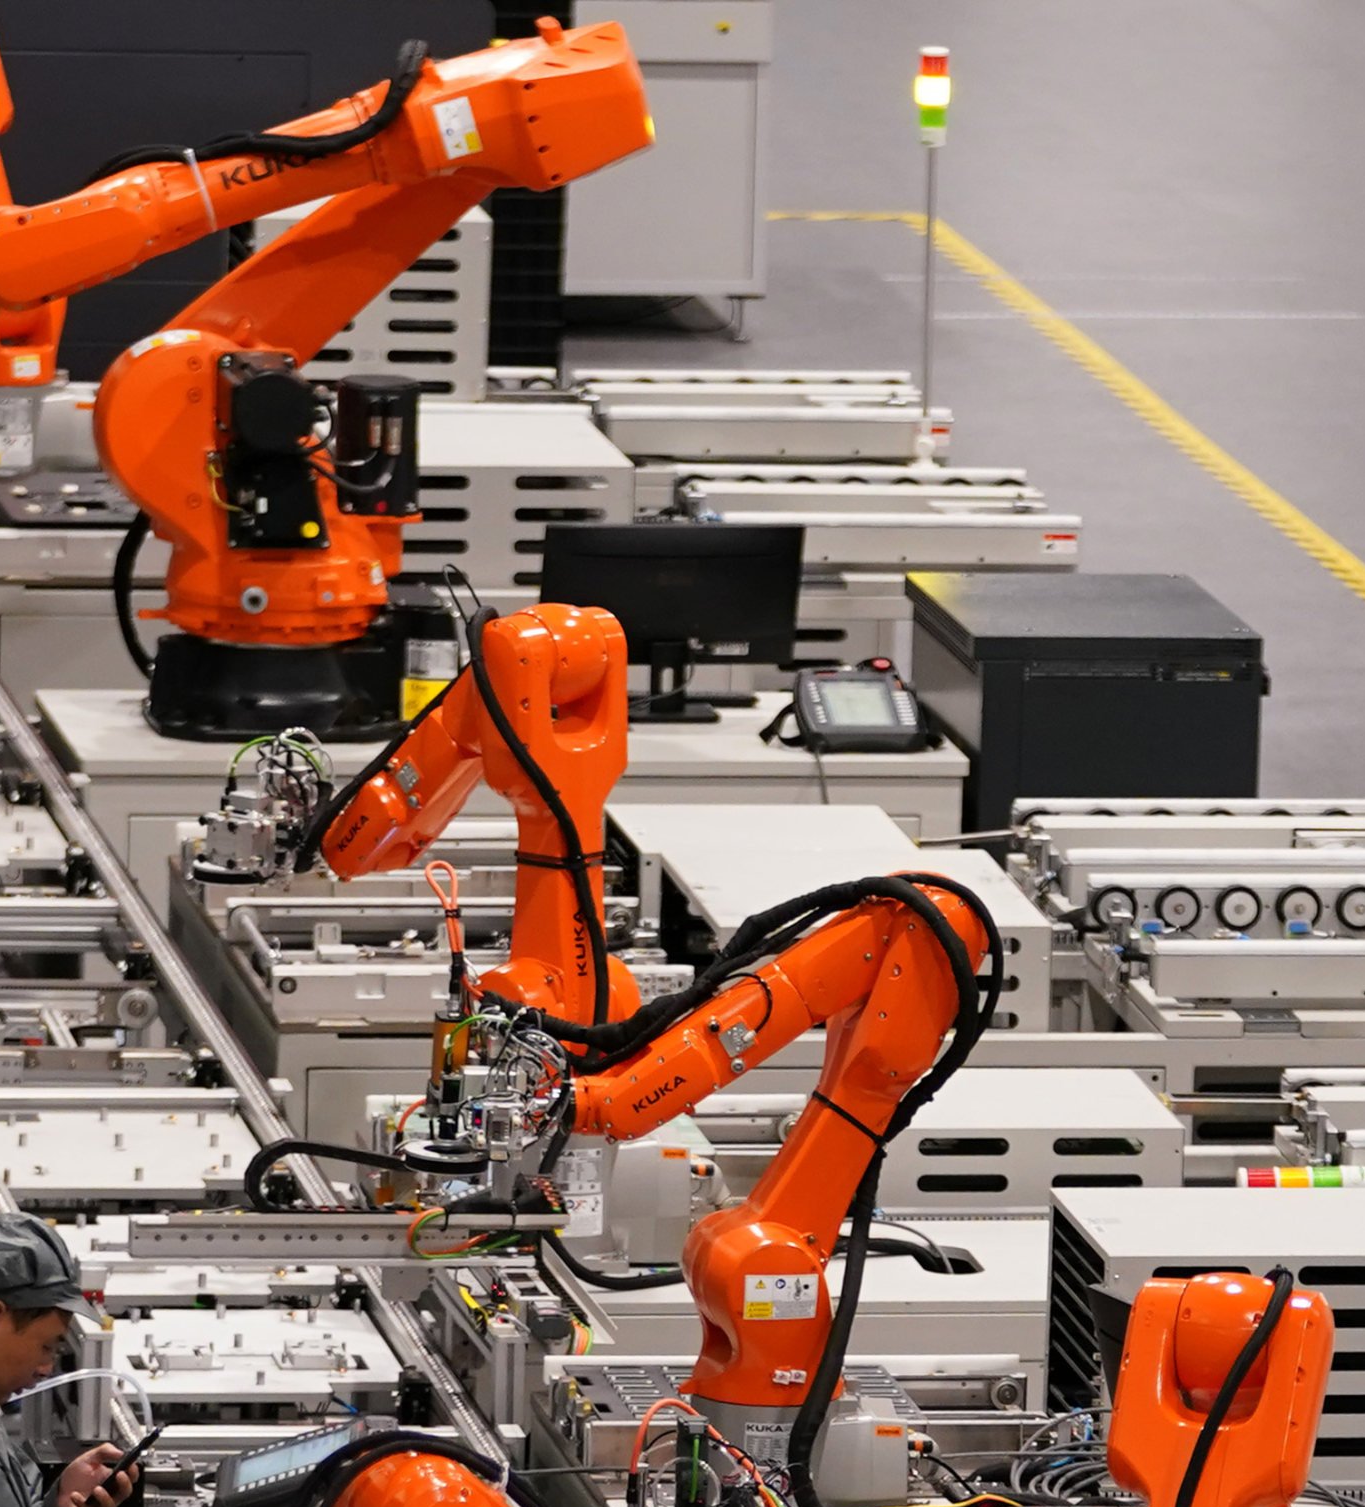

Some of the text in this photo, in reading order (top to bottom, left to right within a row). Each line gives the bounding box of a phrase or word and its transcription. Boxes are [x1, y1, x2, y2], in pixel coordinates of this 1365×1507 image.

[338, 815, 369, 852] KUKA
[632, 1075, 686, 1113] KUKA
[746, 1424, 784, 1433] KUKA
